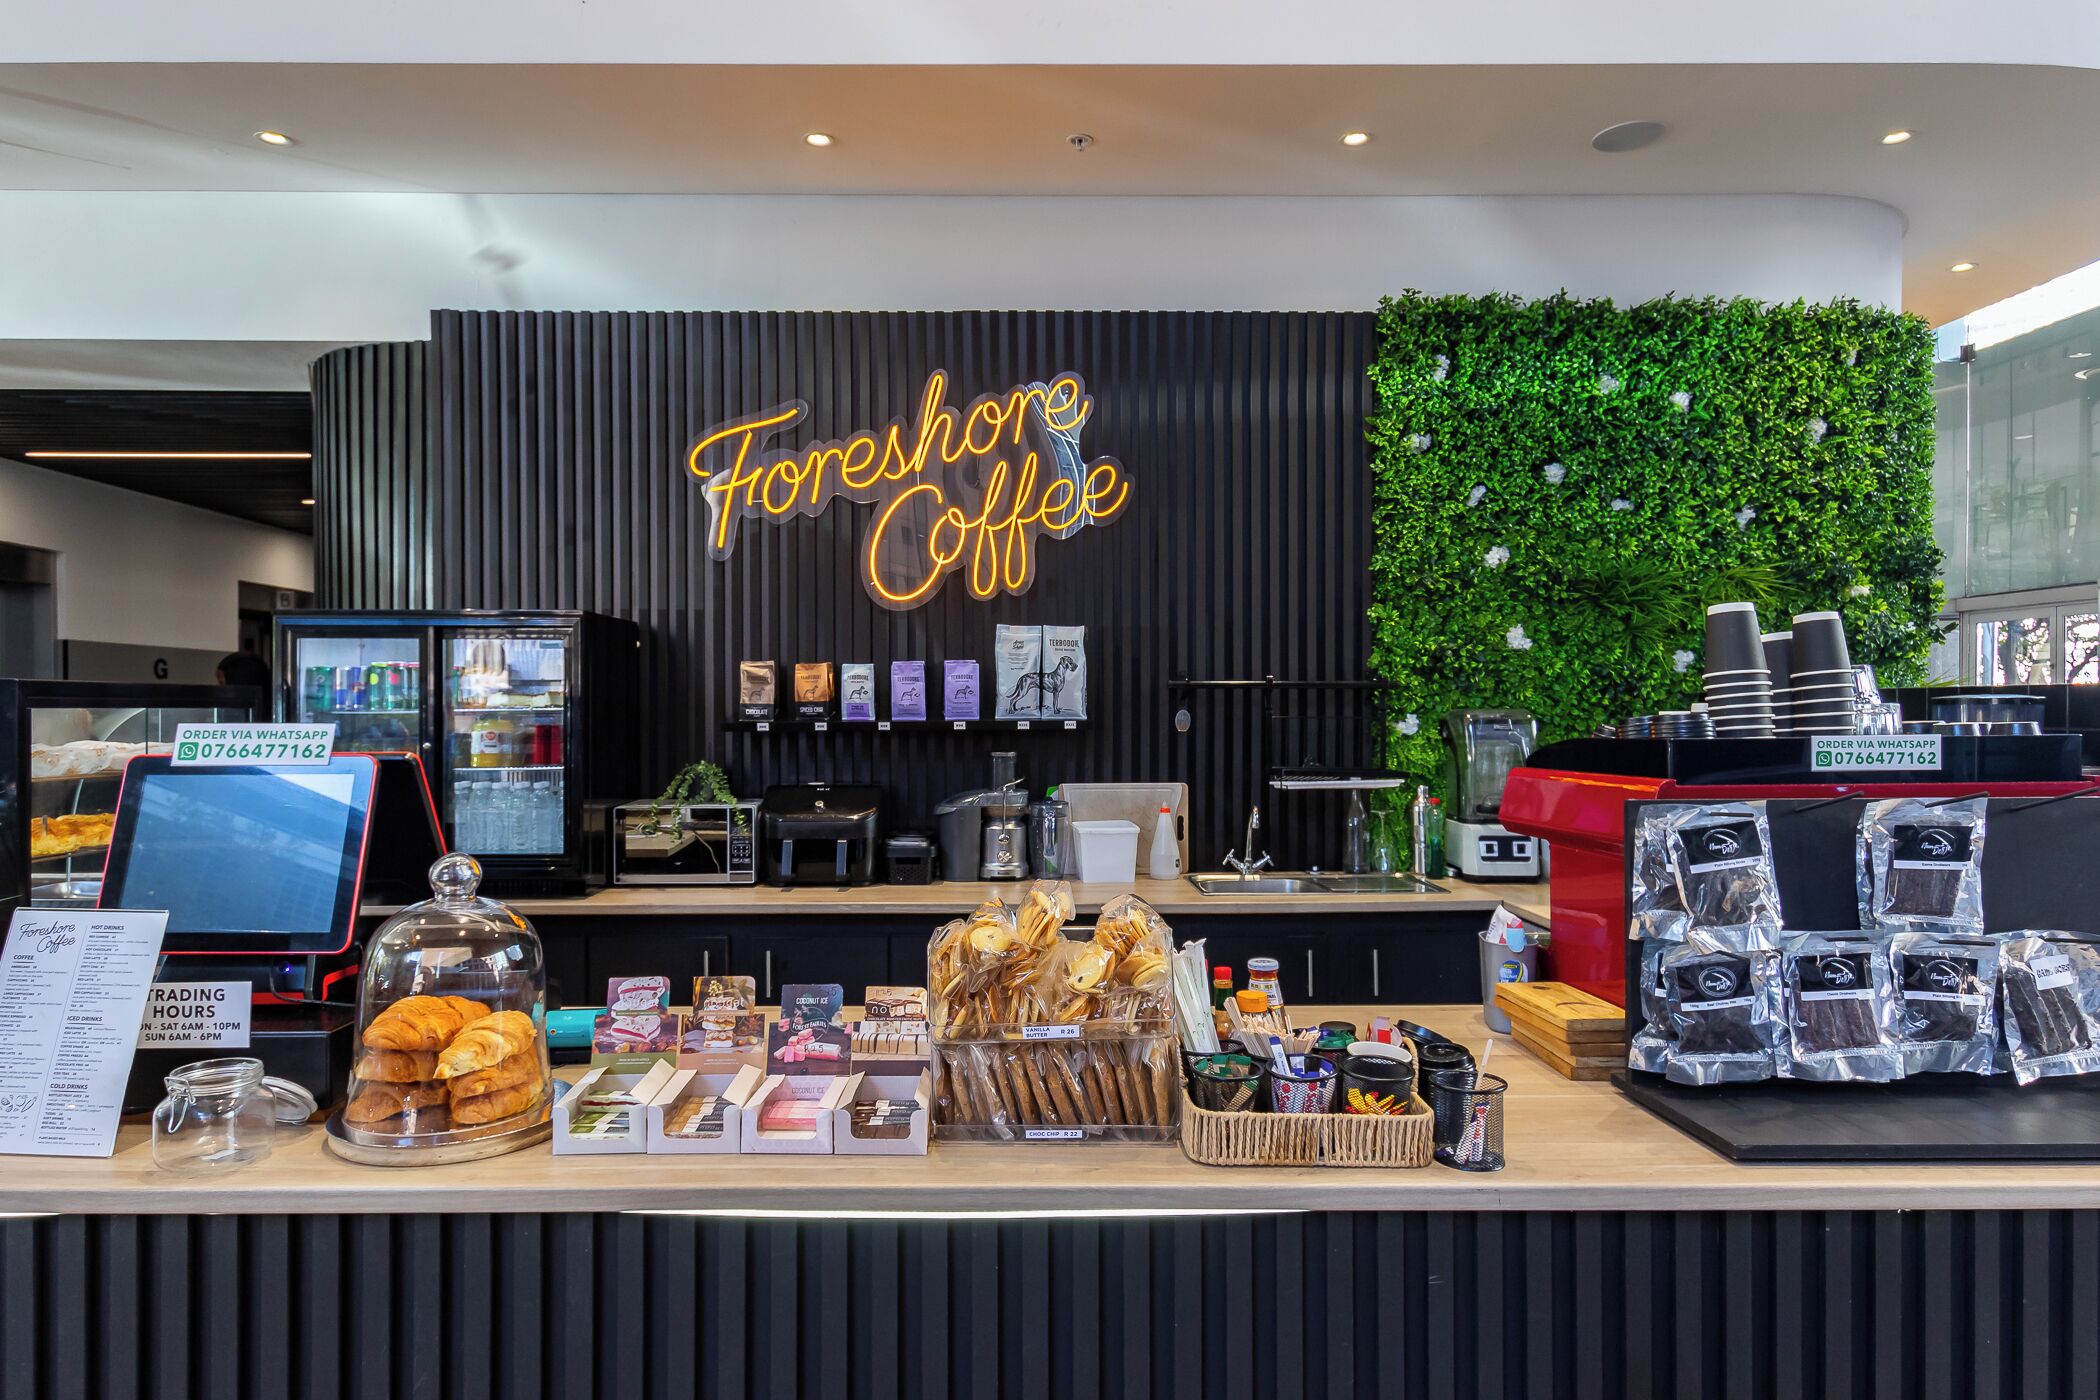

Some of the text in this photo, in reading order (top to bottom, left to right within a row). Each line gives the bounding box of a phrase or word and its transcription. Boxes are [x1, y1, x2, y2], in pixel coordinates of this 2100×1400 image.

[689, 374, 1090, 549] Foreshore
[870, 451, 1129, 601] Coffee
[153, 658, 169, 680] G
[182, 729, 329, 740] ORDER VIA WHATSAPP
[201, 743, 327, 759] 0766477162
[1817, 740, 1936, 749] ORDER VIA WHATSAPP
[1834, 751, 1937, 765] 0766477162
[18, 920, 76, 941] Foreshore
[36, 934, 77, 954] Coffee
[147, 988, 226, 1002] TRADING
[153, 1005, 216, 1018] HOURS
[160, 1022, 179, 1031] SAT
[181, 1022, 204, 1030] 6AM
[213, 1022, 241, 1030] 10PM
[145, 1033, 166, 1041] SUN
[168, 1033, 191, 1041] 6AM
[200, 1033, 222, 1041] 6PM
[791, 1087, 815, 1095] COCONUT
